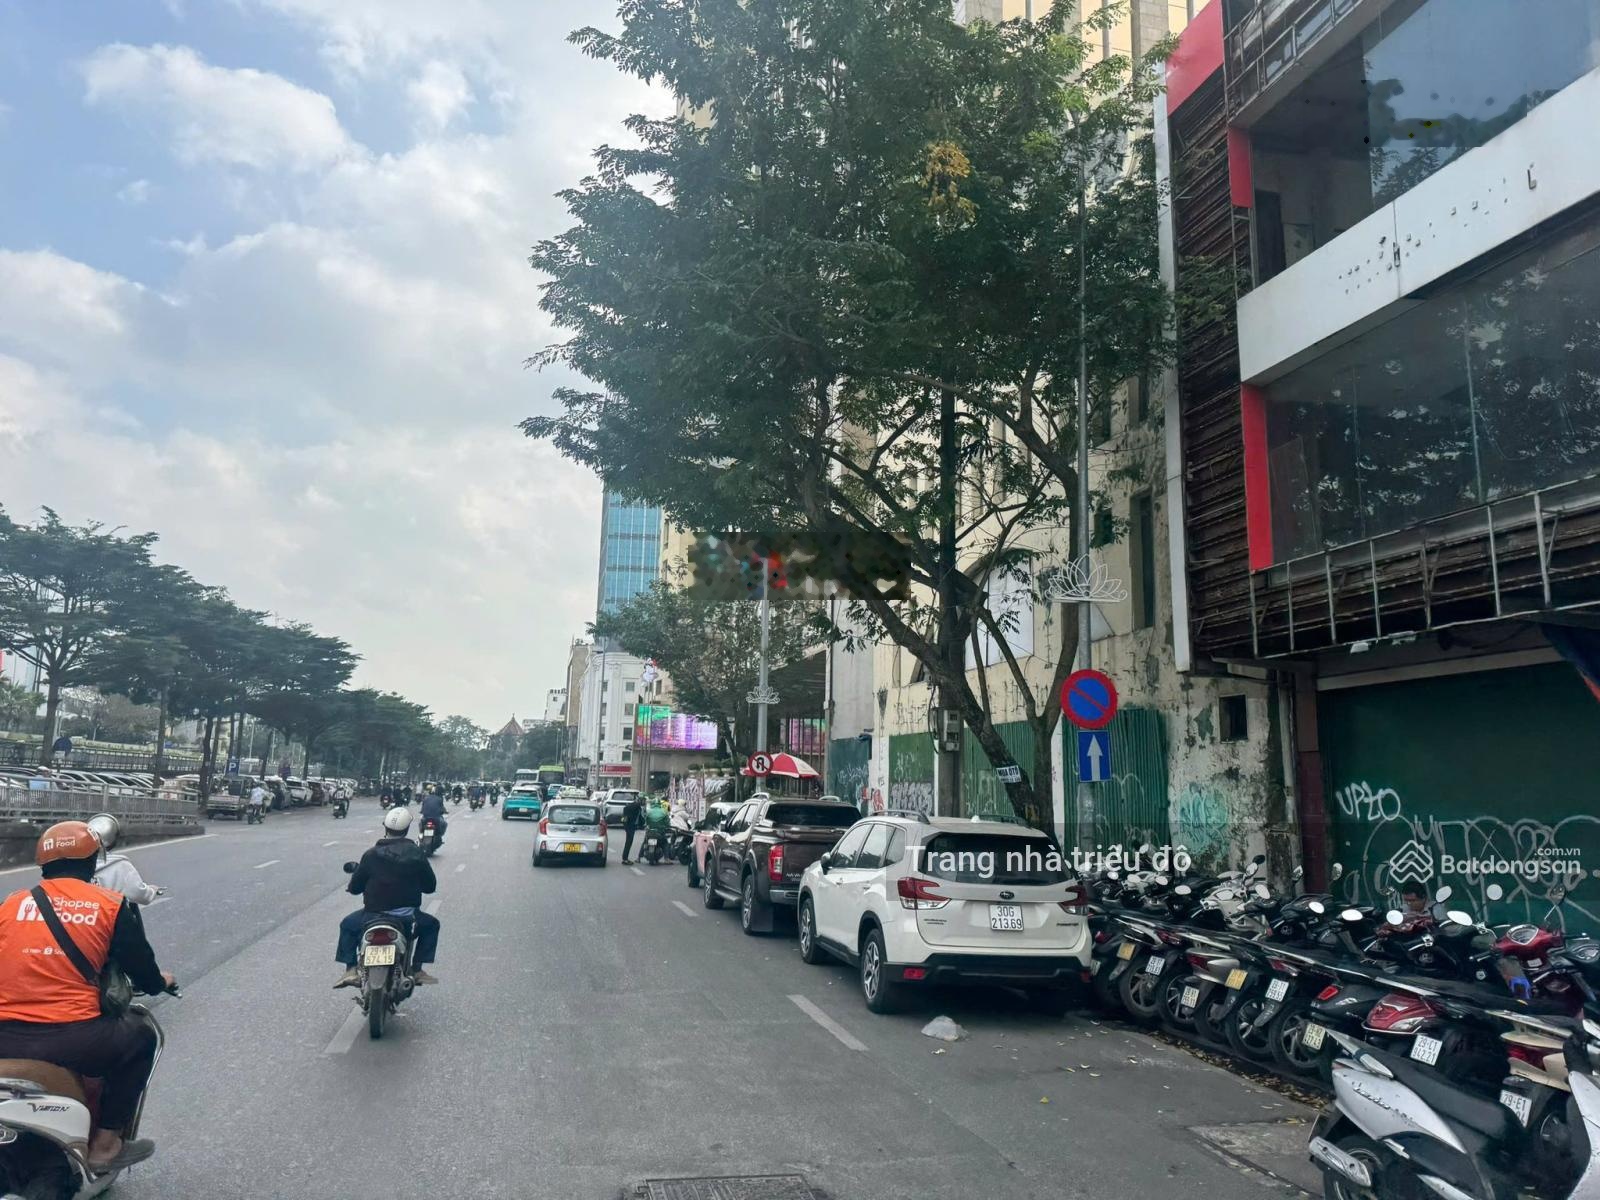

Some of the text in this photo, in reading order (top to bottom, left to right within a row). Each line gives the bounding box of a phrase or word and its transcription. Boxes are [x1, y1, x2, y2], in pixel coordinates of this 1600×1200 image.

[56, 840, 76, 848] Food
[54, 896, 100, 910] Shopee
[997, 905, 1015, 917] 30G
[991, 917, 1023, 929] 213.69
